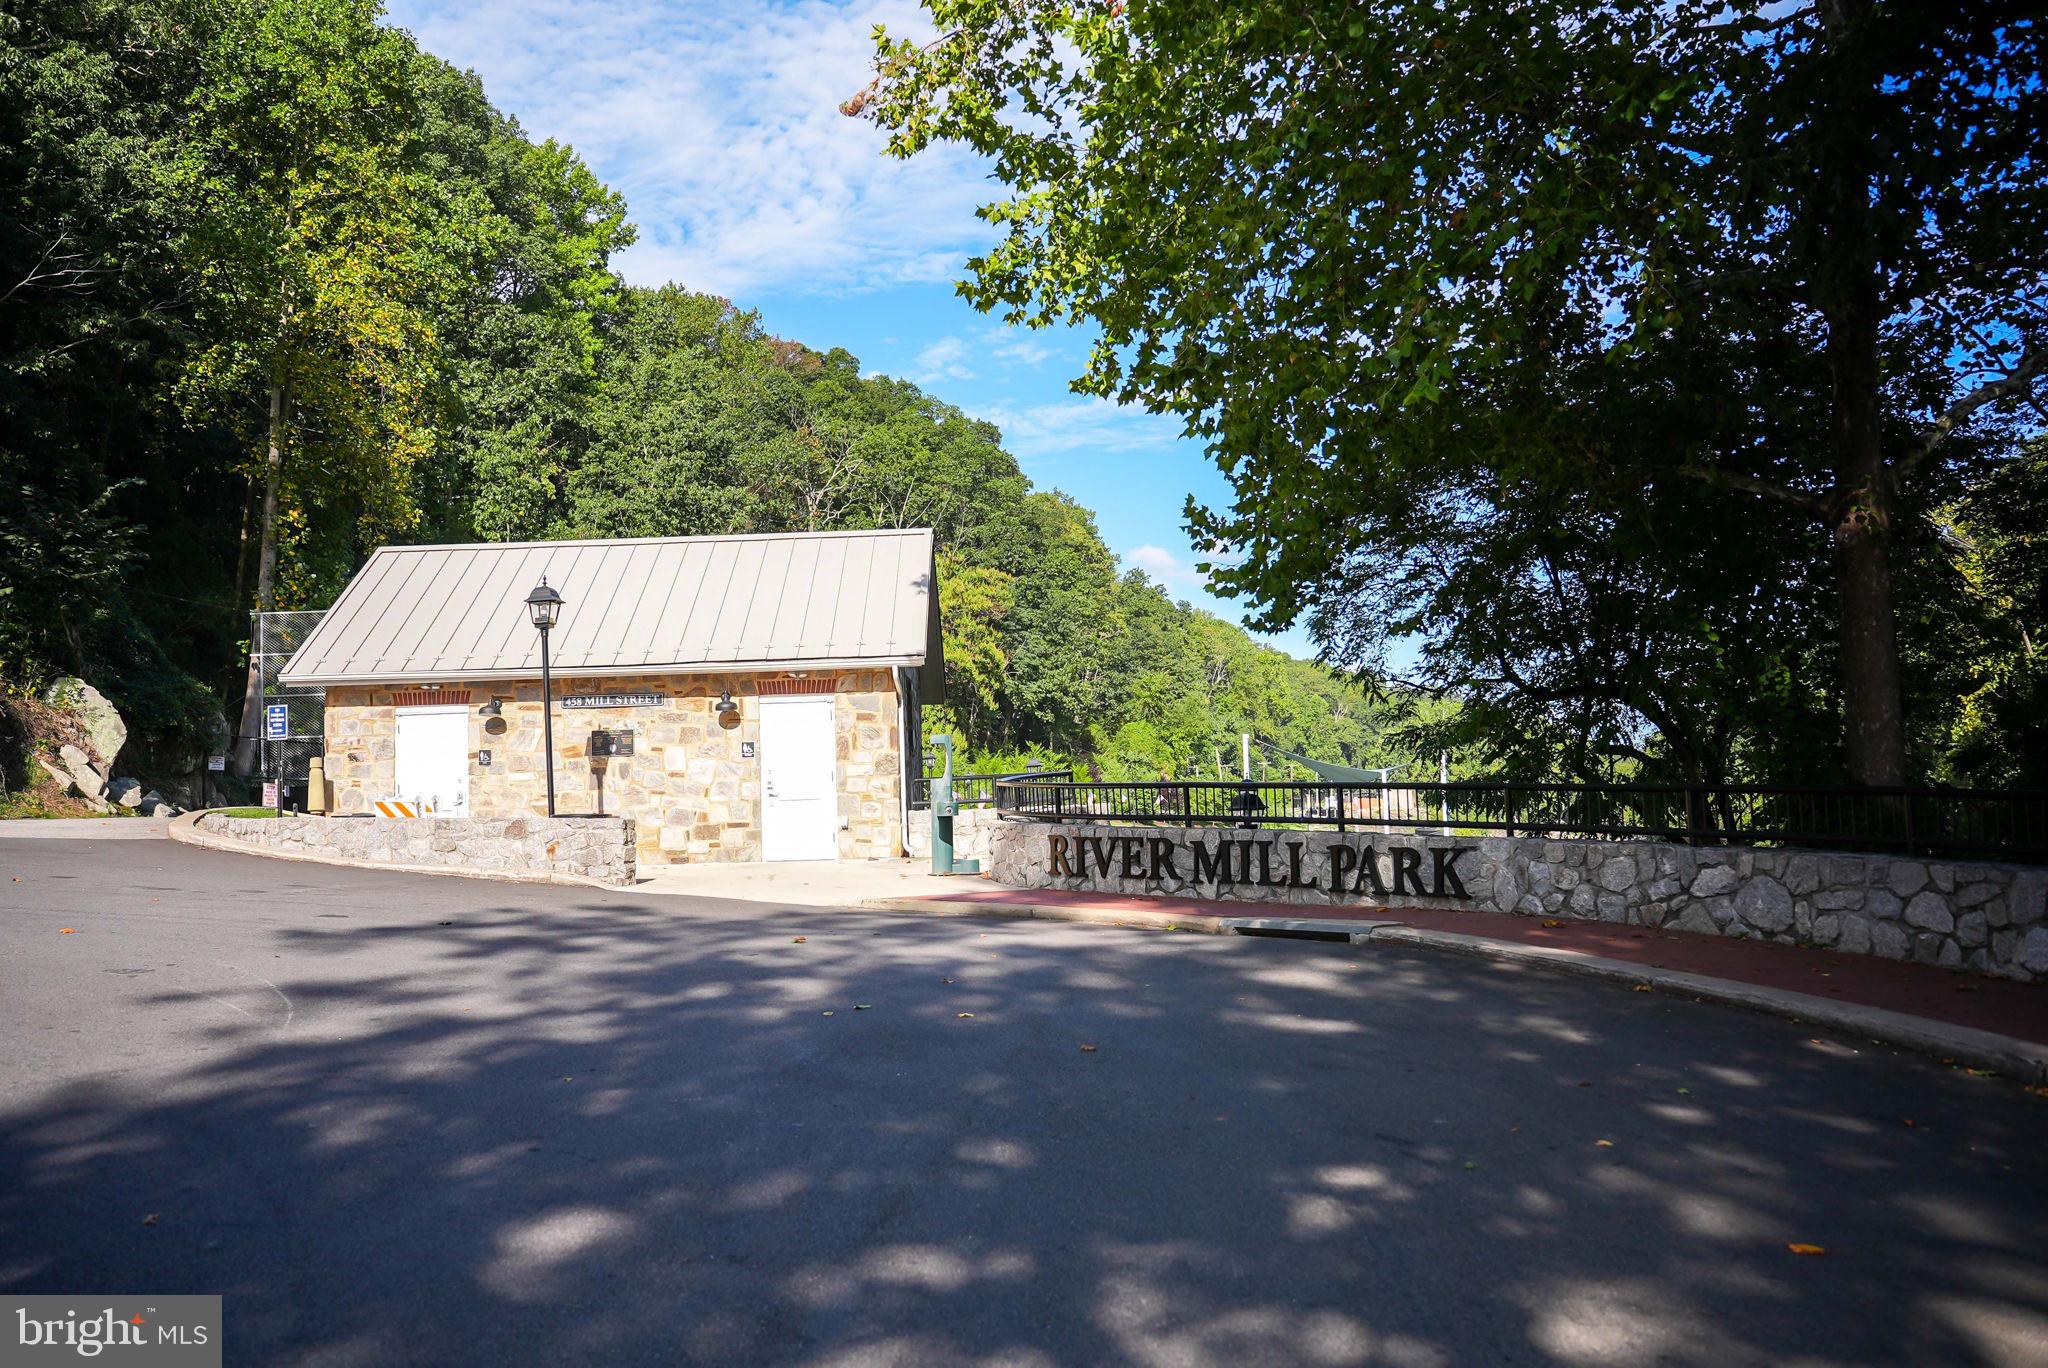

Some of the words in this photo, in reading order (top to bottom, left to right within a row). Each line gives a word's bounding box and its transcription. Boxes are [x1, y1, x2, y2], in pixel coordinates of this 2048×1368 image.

[565, 698, 582, 706] 458
[585, 696, 613, 705] MILL
[616, 694, 660, 704] STREET
[1048, 834, 1184, 880] RIVER
[1189, 840, 1317, 889] MILL
[1326, 844, 1479, 900] PARK
